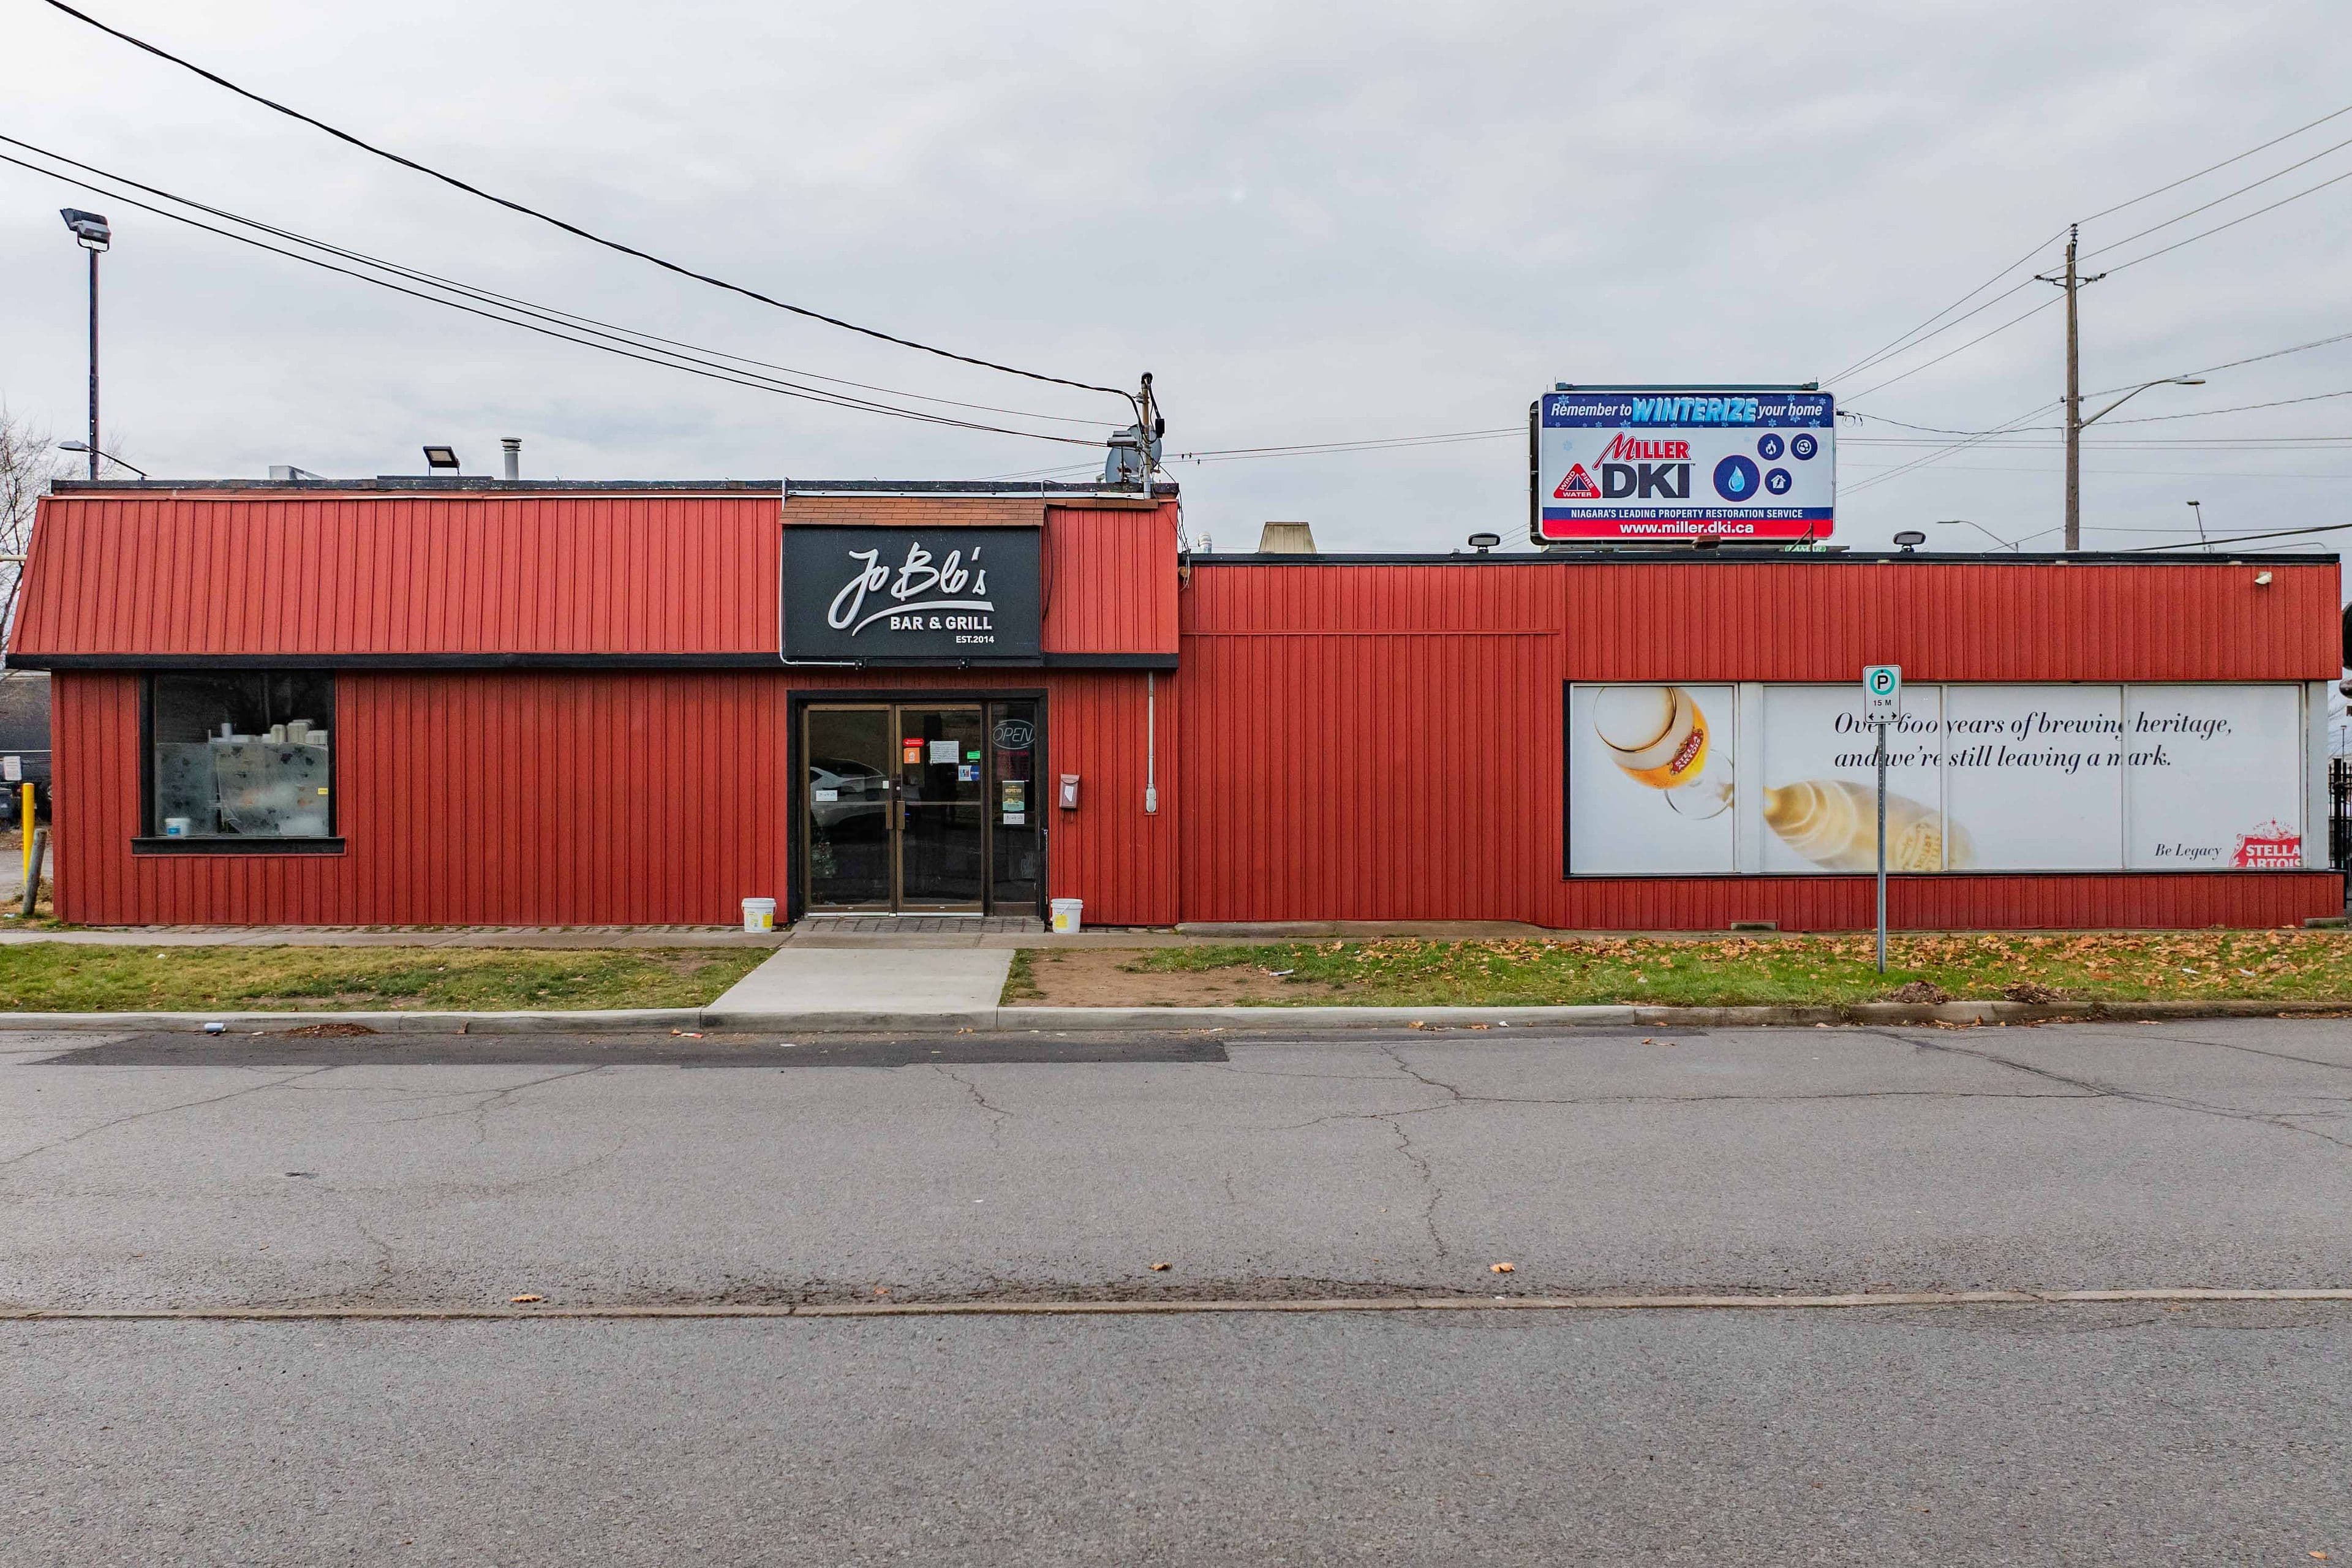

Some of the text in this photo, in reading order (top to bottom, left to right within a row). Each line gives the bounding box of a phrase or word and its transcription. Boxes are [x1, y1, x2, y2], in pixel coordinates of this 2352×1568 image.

[1551, 397, 1823, 423] Remember to WINTERIZE your home
[1593, 431, 1692, 470] MILLER
[1559, 470, 1575, 491] WIND
[1580, 472, 1594, 489] FIRE
[1602, 464, 1690, 499] DKI
[1571, 509, 1803, 518] NIAGARA'S LEADING PROPERTY RESTORATION SERVICE
[1619, 521, 1754, 533] www.miller.dki.ca
[890, 616, 992, 630] BAR & GRILL
[956, 635, 995, 644] EST.2014
[1877, 675, 1889, 690] P
[992, 727, 1033, 742] OPEN
[1834, 712, 1891, 734] Ove
[1947, 718, 2005, 740] years
[2011, 711, 2038, 742] of
[2135, 711, 2231, 741] heritage,
[1834, 745, 1879, 767] and
[1885, 745, 1942, 767] we're
[1948, 745, 1992, 767] still
[1997, 745, 2081, 775] leaving
[2087, 753, 2100, 766] a
[2155, 843, 2222, 861] Be Legacy
[2245, 845, 2301, 856] STELLA
